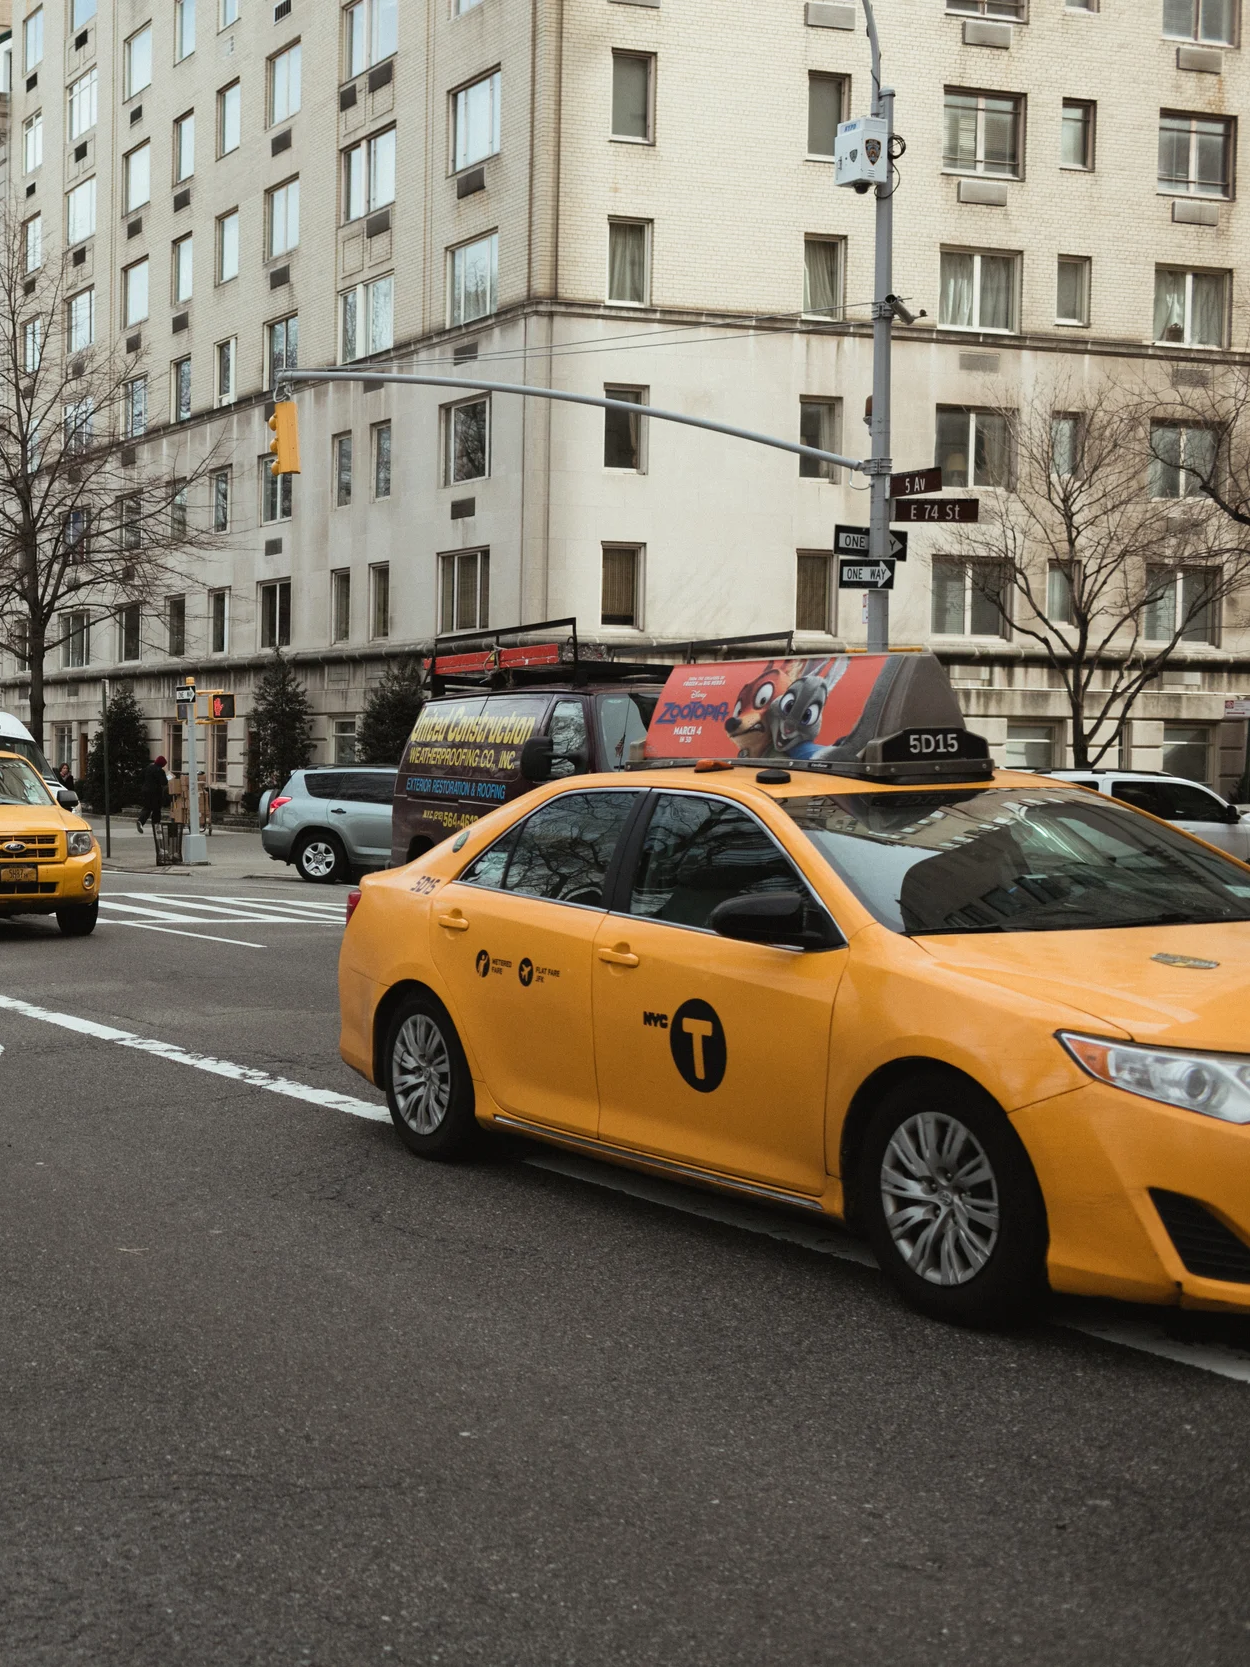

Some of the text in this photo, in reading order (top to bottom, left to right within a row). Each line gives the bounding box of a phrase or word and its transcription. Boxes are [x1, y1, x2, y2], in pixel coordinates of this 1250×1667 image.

[905, 477, 926, 493] 5 Av
[911, 505, 960, 520] E 74 St
[845, 535, 865, 548] ONE
[846, 568, 887, 580] ONE WAY
[691, 689, 707, 700] Disney
[411, 705, 536, 745] United Construction
[673, 726, 702, 736] MARCH 4
[909, 733, 959, 754] 5D15
[409, 747, 480, 767] WEATHERPROOFING
[498, 750, 516, 770] INC.
[406, 778, 506, 799] EXTERIOR RESTORATION & ROOFING
[410, 875, 441, 895] 5D15
[492, 959, 512, 968] METERED
[492, 967, 503, 975] FARE
[535, 966, 560, 977] FLAT FARE
[535, 975, 544, 983] JFK
[643, 1011, 668, 1029] NYC
[682, 1017, 713, 1080] T
